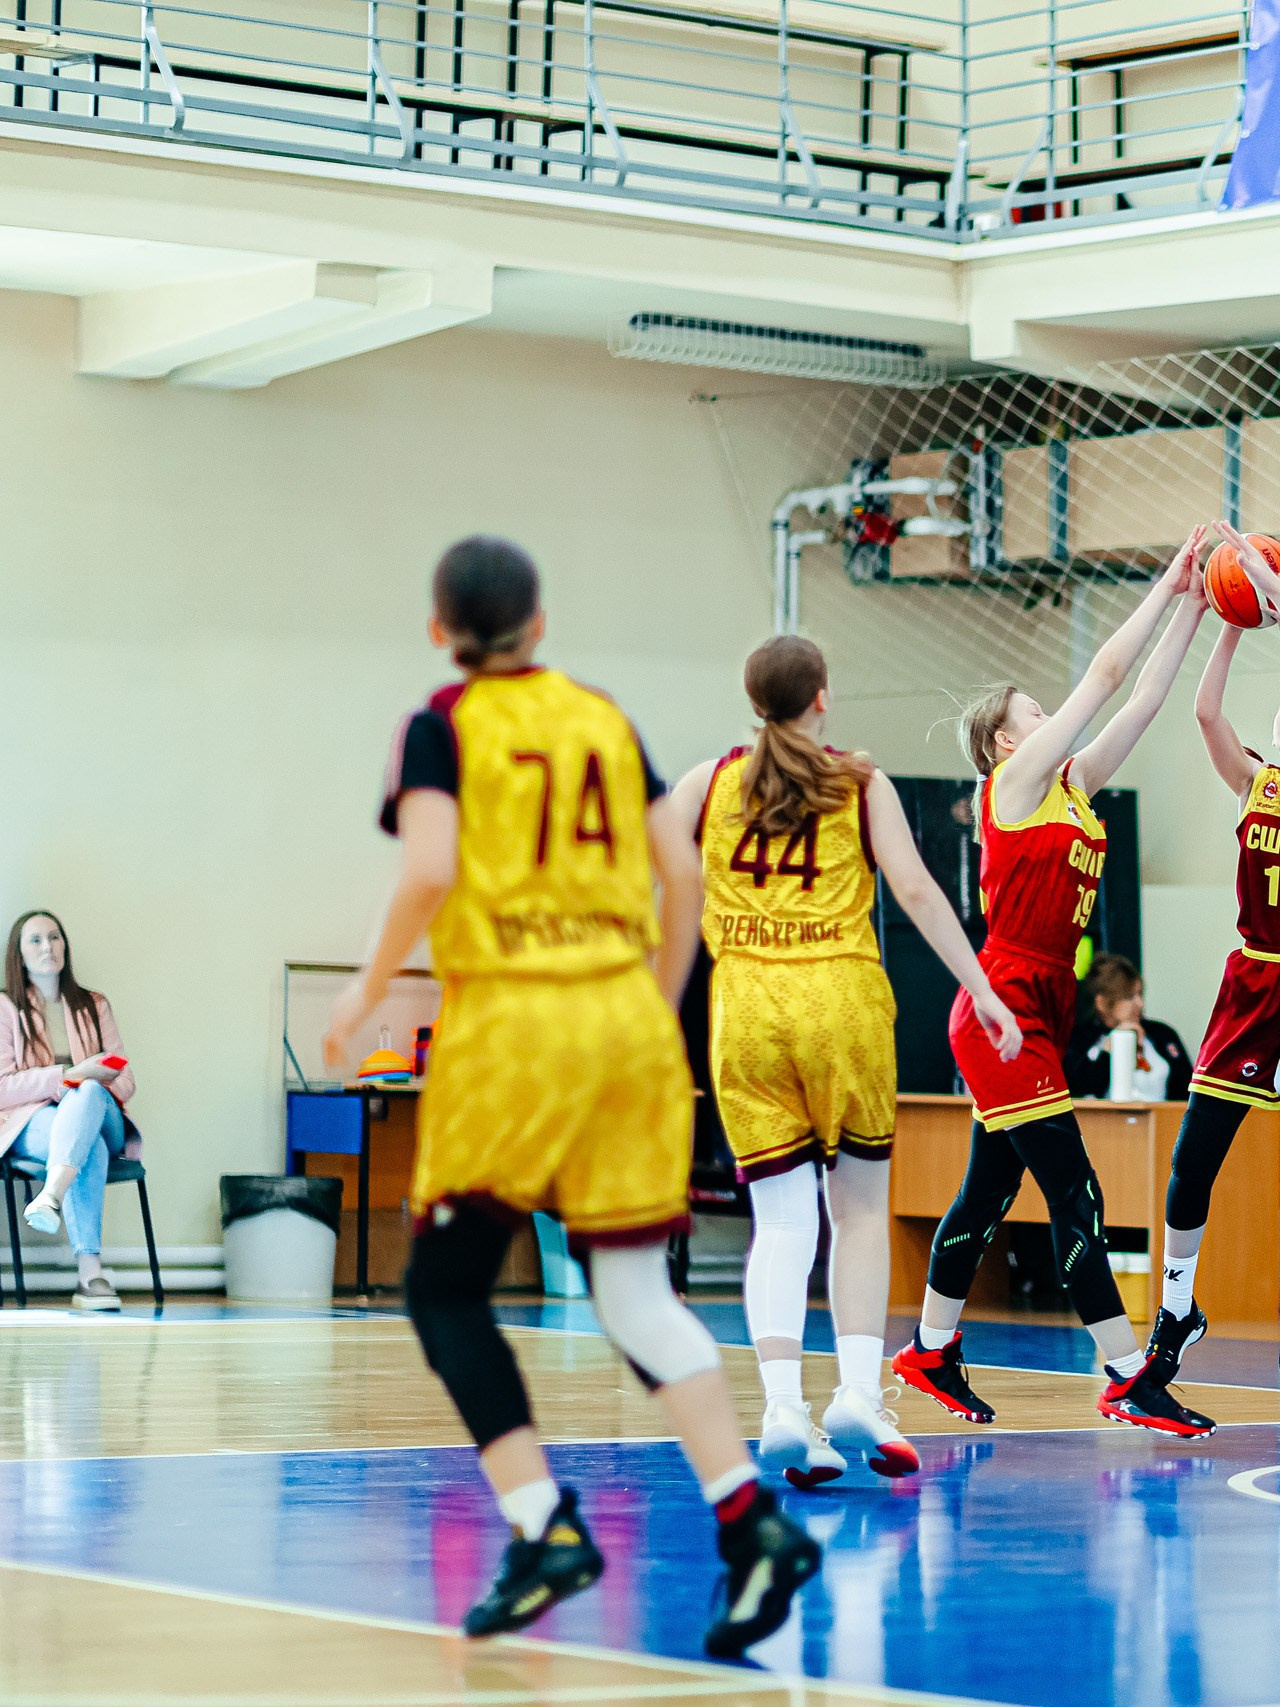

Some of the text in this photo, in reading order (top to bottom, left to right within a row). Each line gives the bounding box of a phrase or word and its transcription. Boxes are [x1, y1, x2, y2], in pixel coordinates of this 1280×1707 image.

[511, 748, 617, 870] 74
[730, 811, 822, 893] 44
[715, 913, 844, 948] РЕНБУРЖЬЕ
[1071, 883, 1097, 929] 19
